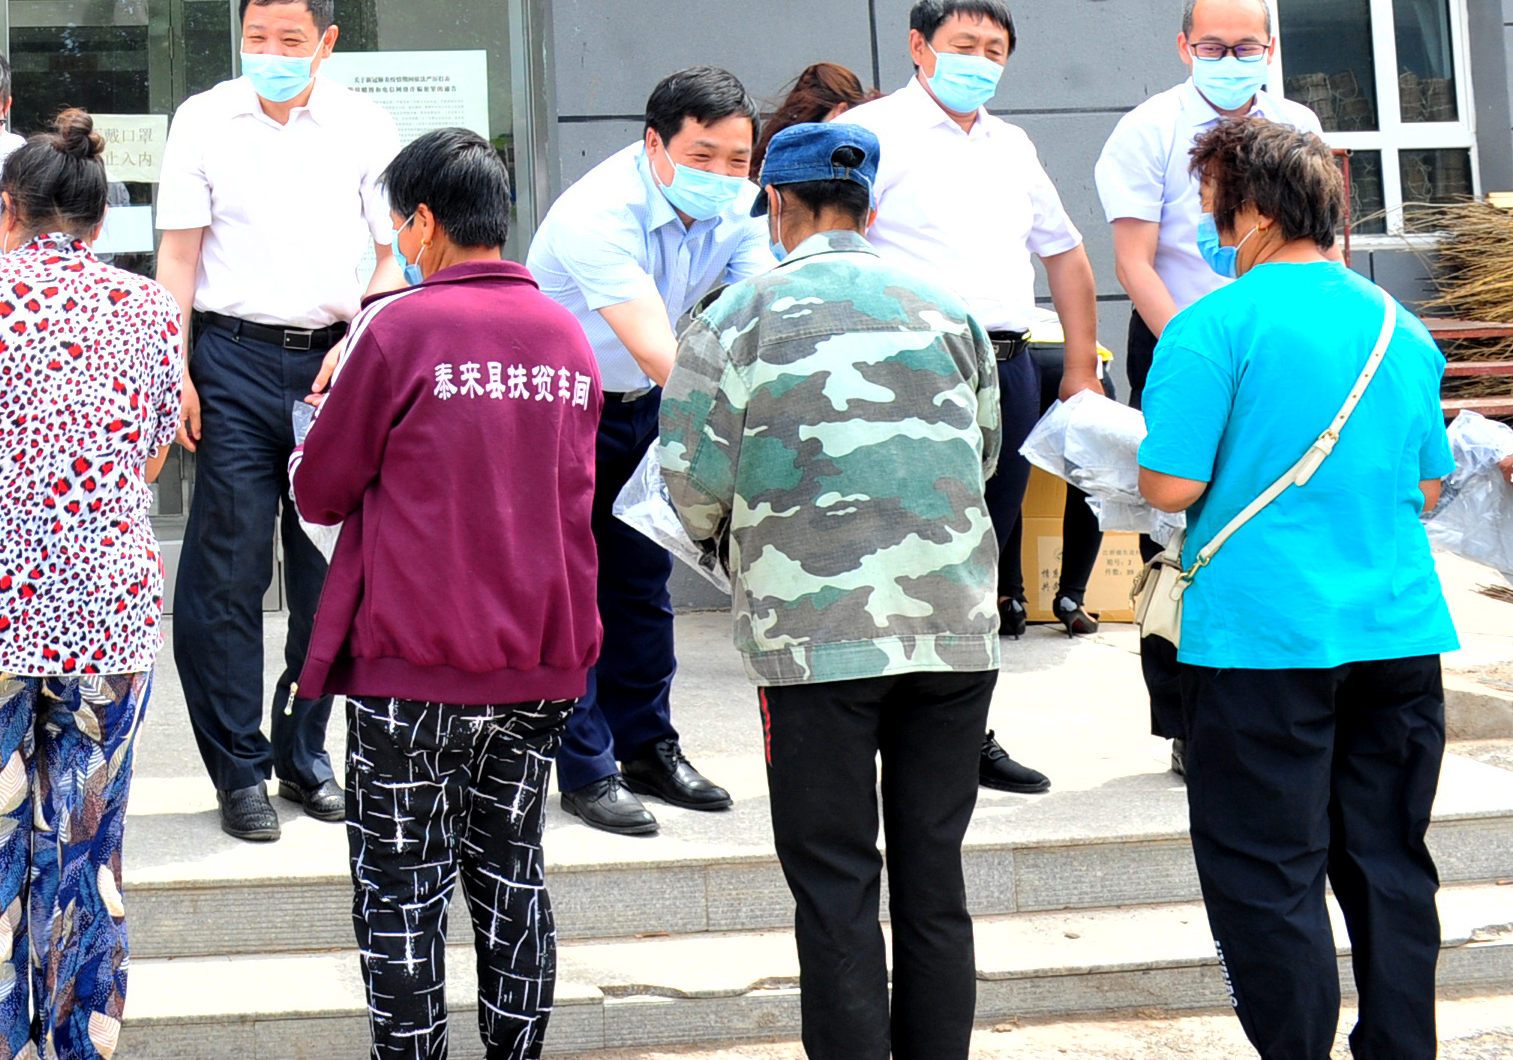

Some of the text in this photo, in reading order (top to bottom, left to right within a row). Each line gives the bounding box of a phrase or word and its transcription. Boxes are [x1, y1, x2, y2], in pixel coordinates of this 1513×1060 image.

[433, 360, 592, 411] 泰来县扶贫车间
